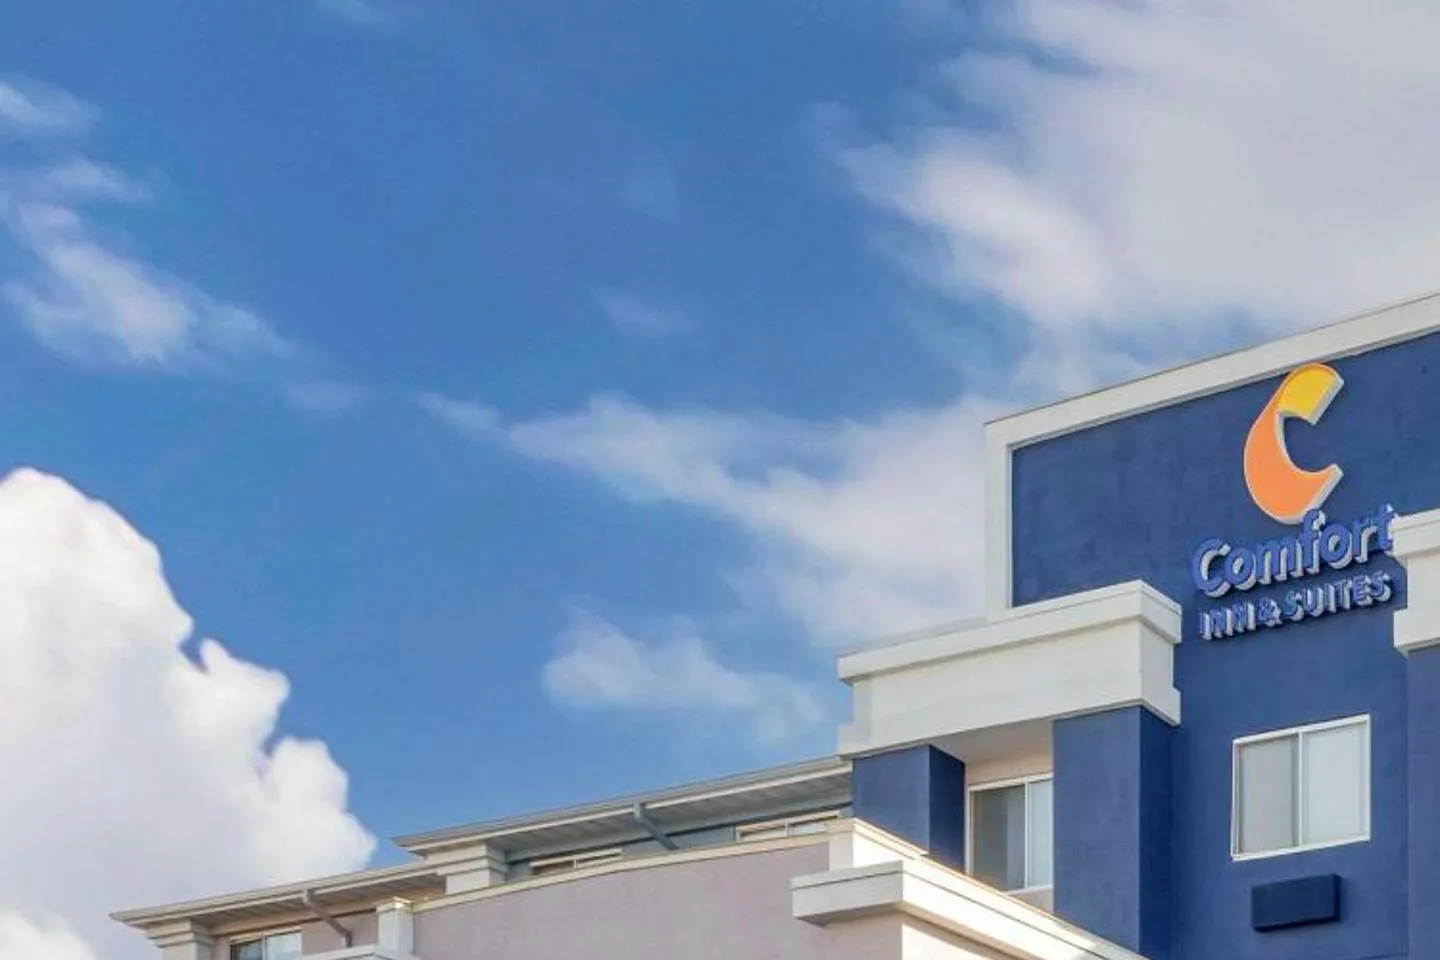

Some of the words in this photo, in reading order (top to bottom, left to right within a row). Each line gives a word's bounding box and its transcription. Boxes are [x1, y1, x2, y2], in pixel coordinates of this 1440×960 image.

[1192, 503, 1397, 598] Comfort
[1200, 600, 1257, 641] INN
[1258, 597, 1283, 628] &
[1284, 569, 1392, 623] SUITES
